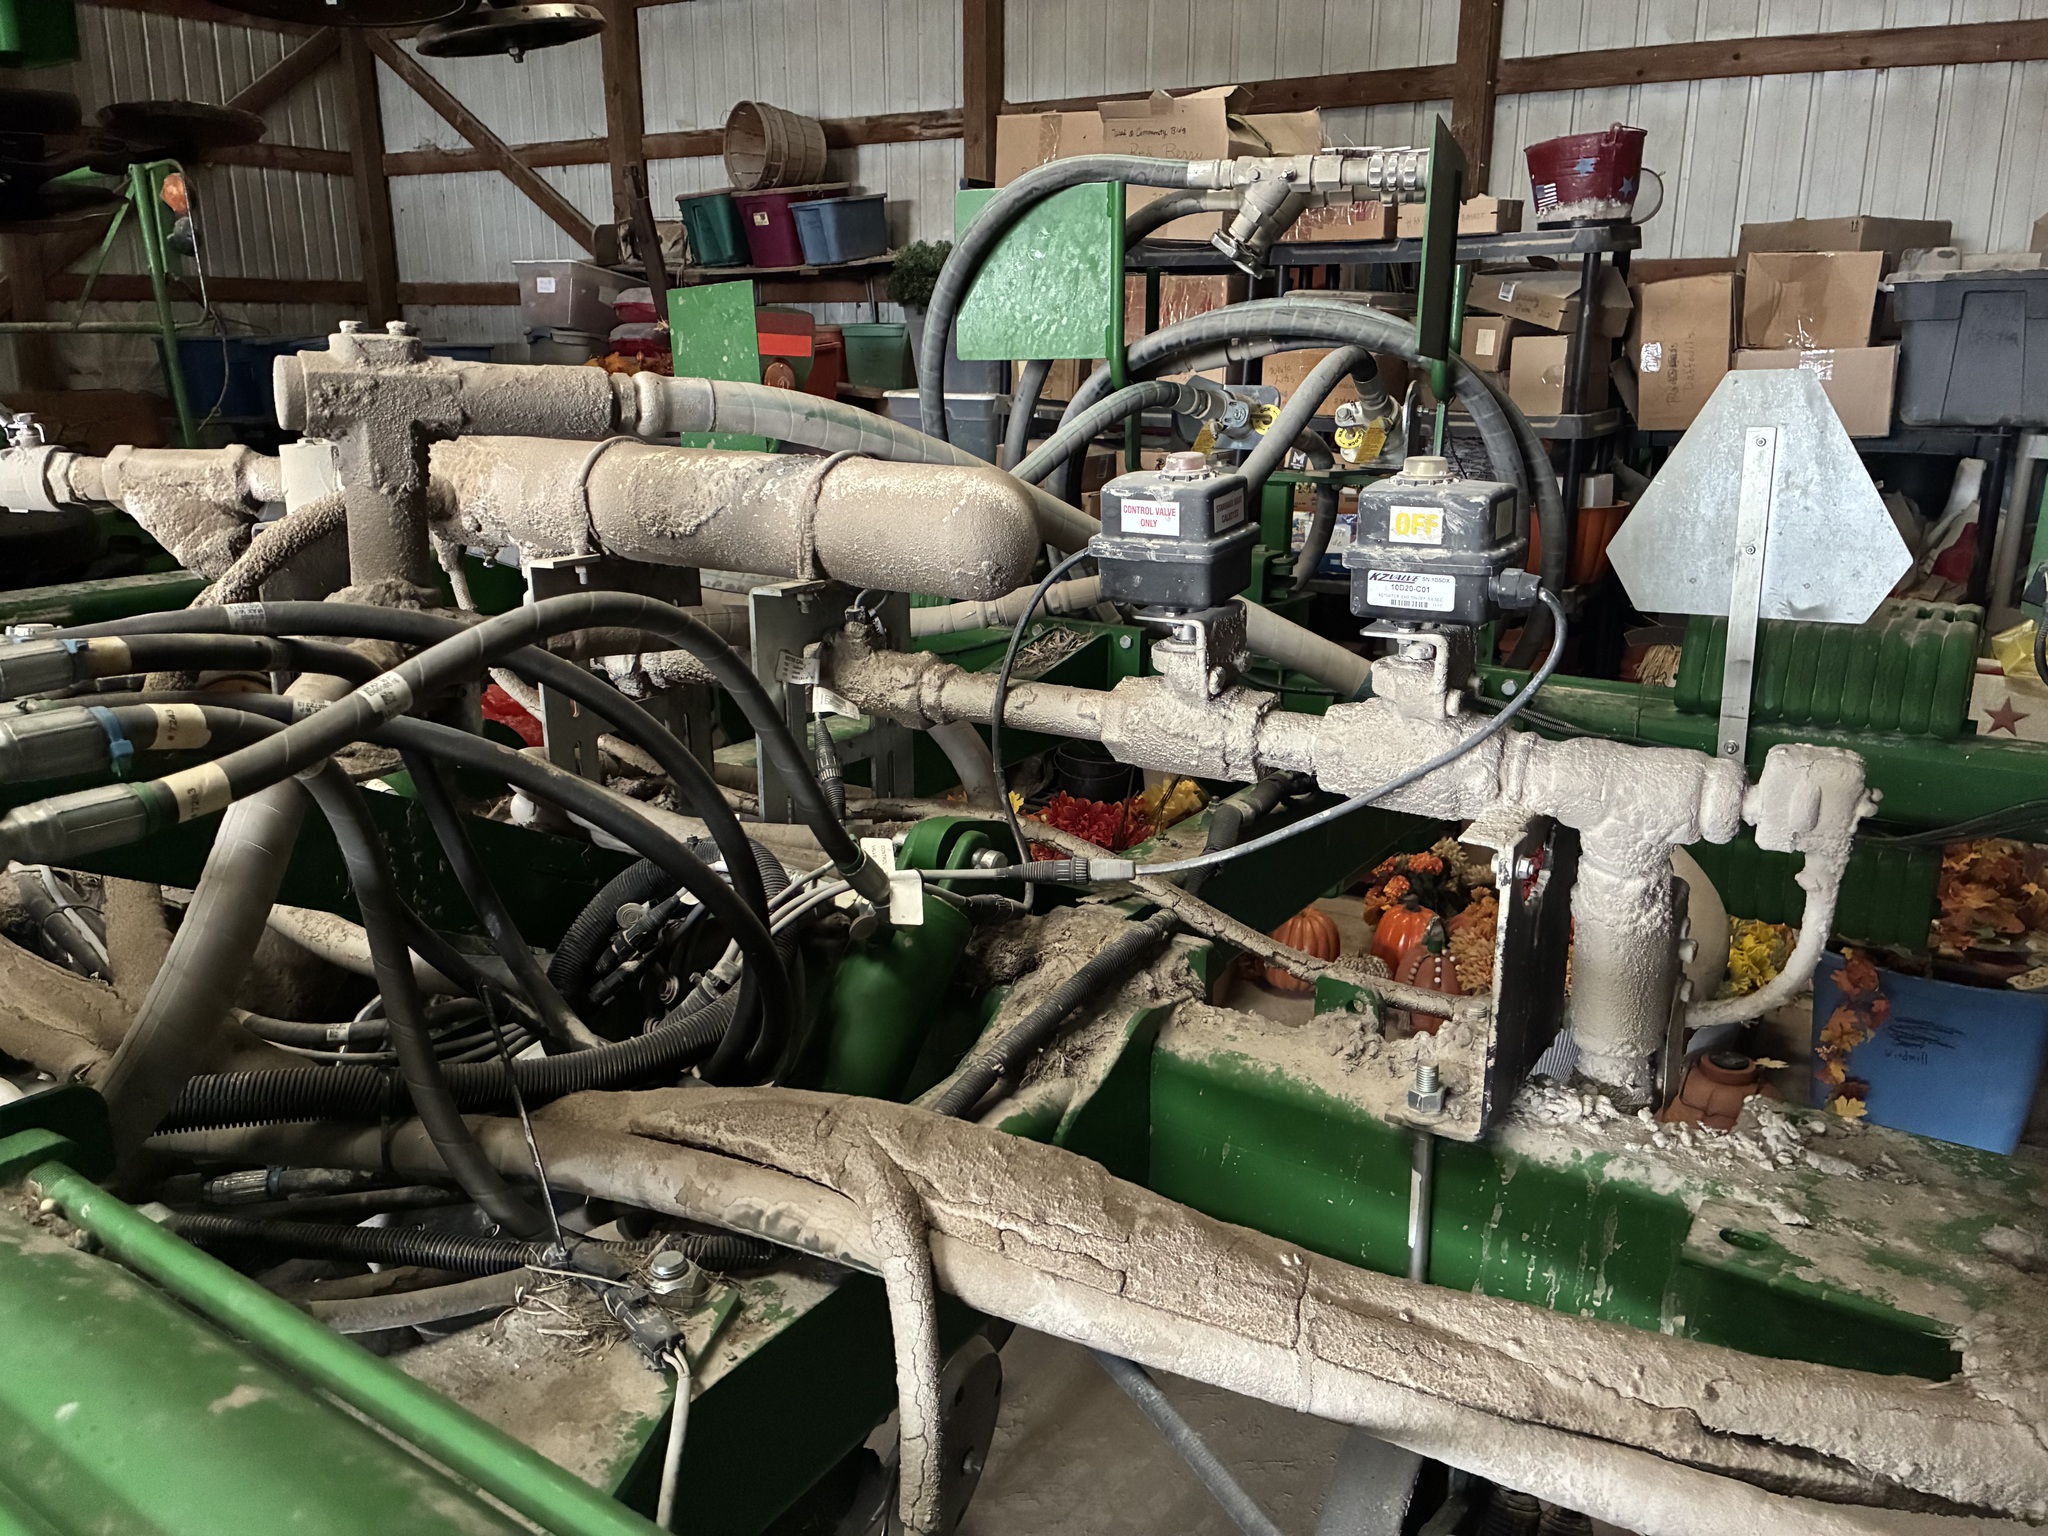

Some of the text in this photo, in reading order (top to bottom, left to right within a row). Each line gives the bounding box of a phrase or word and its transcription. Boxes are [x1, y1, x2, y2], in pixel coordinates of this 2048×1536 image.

[1129, 142, 1153, 156] Red
[1682, 331, 1696, 391] Daffodils
[1123, 505, 1177, 517] CONTROL VALVE
[1140, 518, 1158, 528] ONLY
[1395, 513, 1438, 535] OFF
[1391, 584, 1430, 593] 10D20-C01
[880, 845, 888, 865] CONTROL
